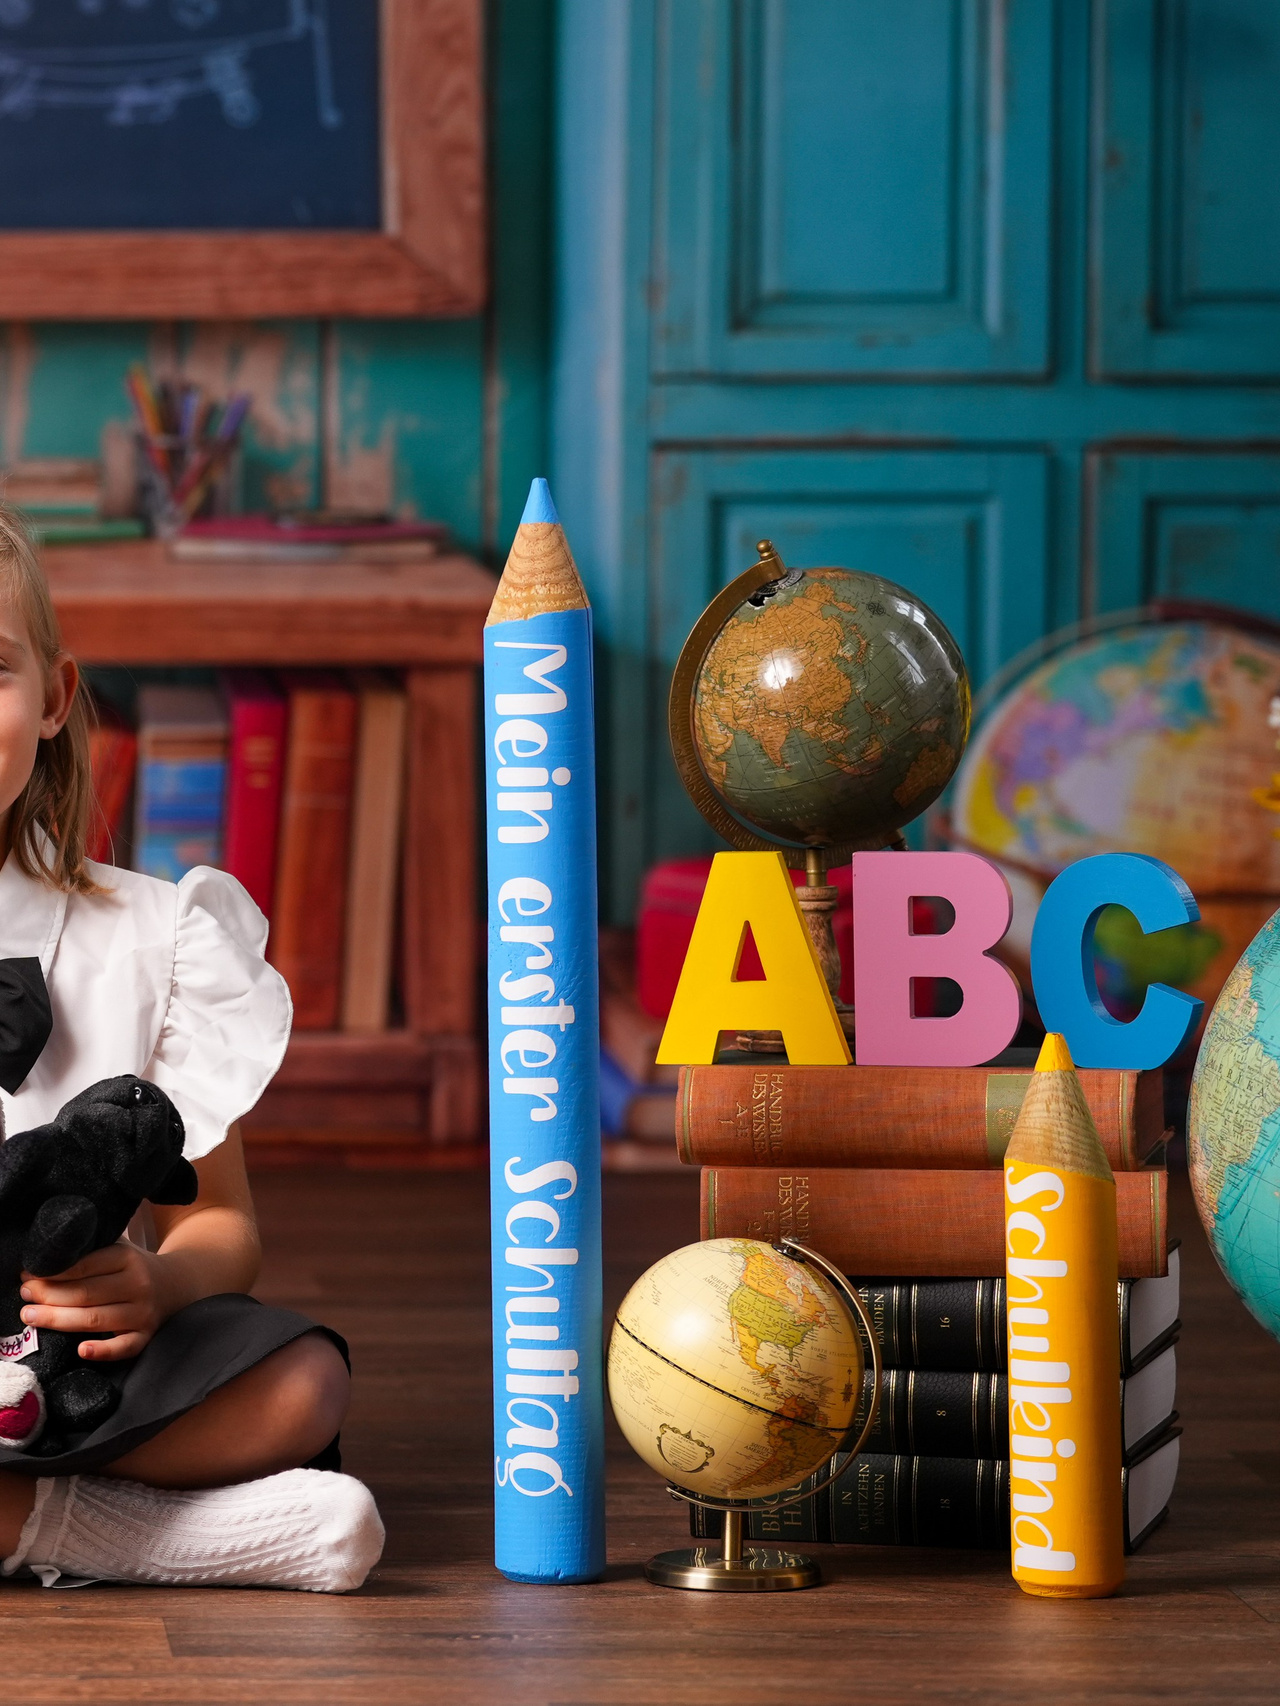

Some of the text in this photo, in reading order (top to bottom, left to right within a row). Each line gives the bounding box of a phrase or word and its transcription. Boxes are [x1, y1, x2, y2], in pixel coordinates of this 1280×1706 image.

[655, 850, 1205, 1070] ABC
[494, 641, 578, 1496] Mein erster Schultag
[752, 1073, 768, 1100] DES
[778, 1176, 793, 1205] DES
[939, 1316, 950, 1328] 16
[1005, 1167, 1075, 1571] Schulkind
[936, 1409, 947, 1417] 8
[761, 1490, 781, 1532] BRO
[841, 1490, 852, 1505] IN
[939, 1497, 951, 1509] 18
